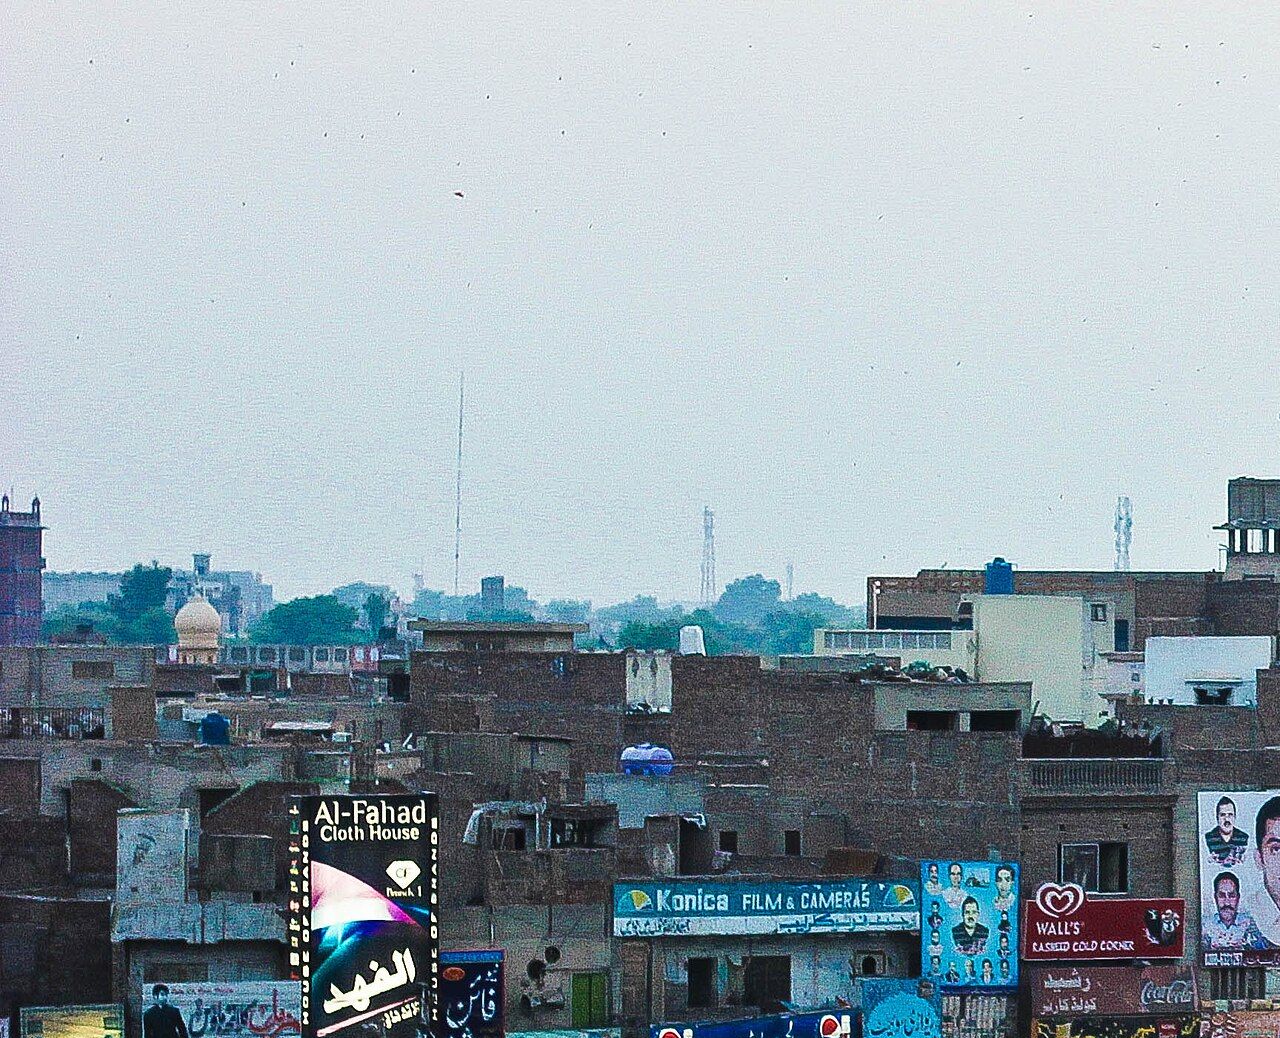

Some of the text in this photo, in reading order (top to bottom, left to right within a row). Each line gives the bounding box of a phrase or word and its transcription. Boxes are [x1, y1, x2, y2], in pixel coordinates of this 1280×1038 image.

[314, 800, 427, 826] Al-Fahad
[320, 823, 421, 843] Cloth House
[656, 888, 870, 911] Konica FILM & CAMERAS
[1036, 921, 1081, 936] WALL'S
[1072, 940, 1098, 951] COLD
[1100, 940, 1135, 951] CORNER
